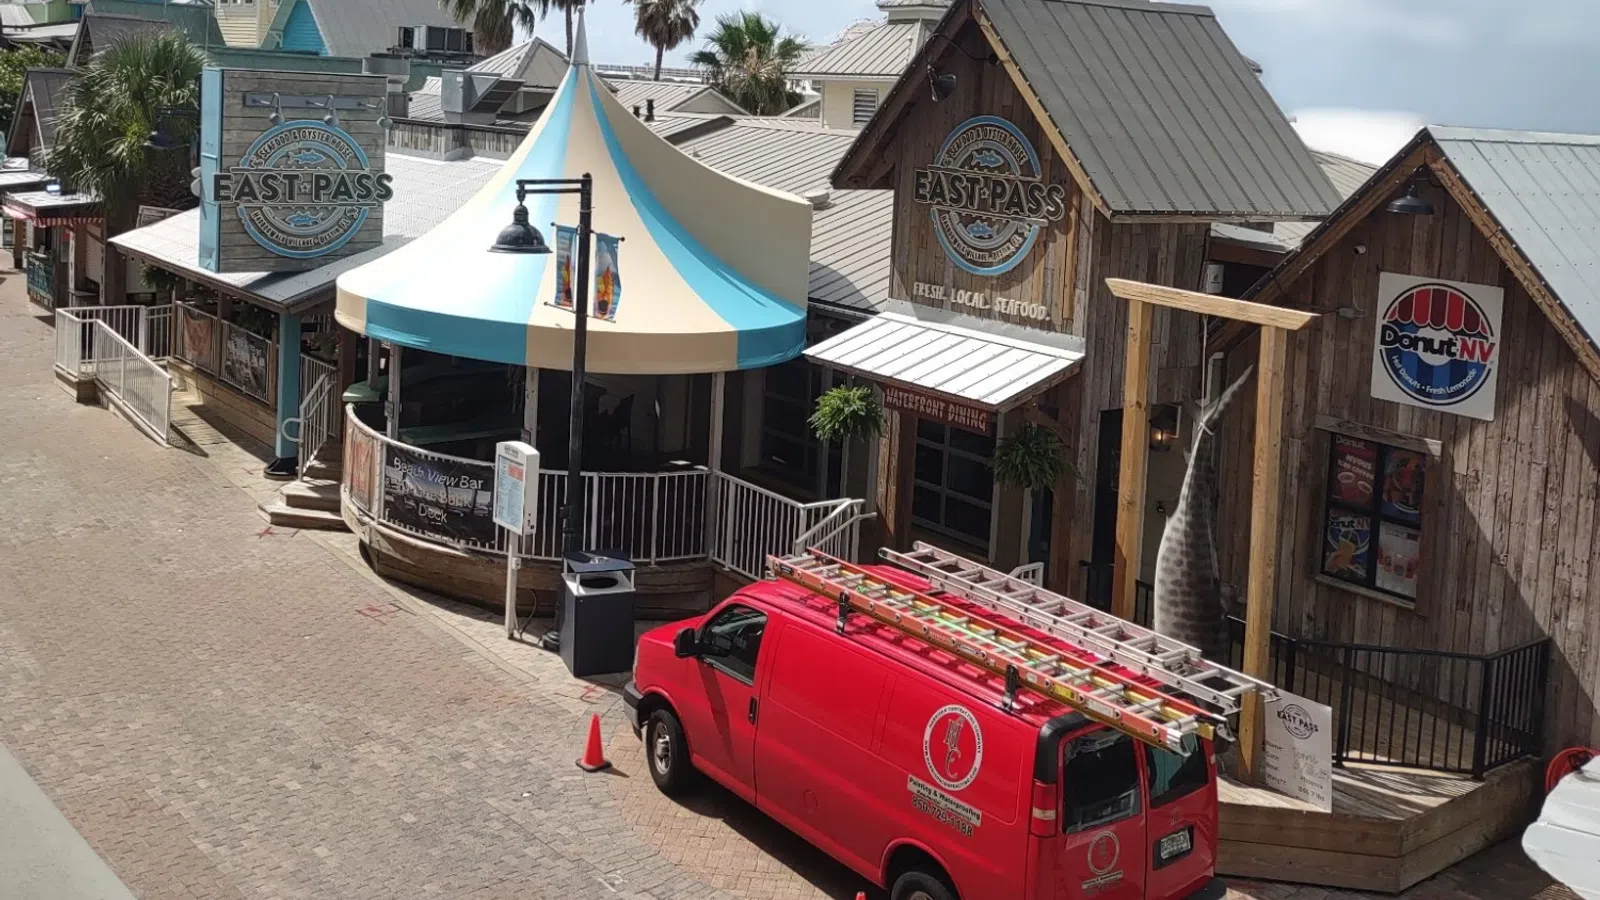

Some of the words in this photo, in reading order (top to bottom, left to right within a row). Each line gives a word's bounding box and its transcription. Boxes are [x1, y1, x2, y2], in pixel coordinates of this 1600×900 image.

[260, 132, 290, 158] SEAFOOD
[292, 131, 298, 140] &
[301, 130, 331, 142] OYSTER
[331, 137, 353, 159] HOUSE
[949, 130, 974, 156] SEAFOOD
[976, 128, 981, 140] &
[983, 127, 1008, 143] OYSTER
[1008, 137, 1027, 163] HOUSE
[213, 173, 300, 201] EAST
[312, 173, 393, 201] PASS
[914, 170, 981, 208] EAST
[991, 181, 1066, 221] PASS
[951, 289, 990, 309] LOCAL.
[994, 297, 1050, 320] SEAFOOD.
[1392, 355, 1401, 369] Hot
[1399, 367, 1421, 390] Donuts
[1426, 386, 1446, 395] Fresh
[1446, 368, 1478, 394] Lemonade
[886, 387, 946, 418] WATERFRONT
[948, 403, 987, 432] DINING
[393, 457, 424, 478] Beach
[427, 468, 458, 487] View
[459, 475, 484, 490] Bar
[418, 503, 448, 524] Deck
[1277, 710, 1297, 725] EAST
[1299, 719, 1319, 732] PASS
[909, 777, 932, 794] Painting
[940, 793, 980, 820] Waterproofing
